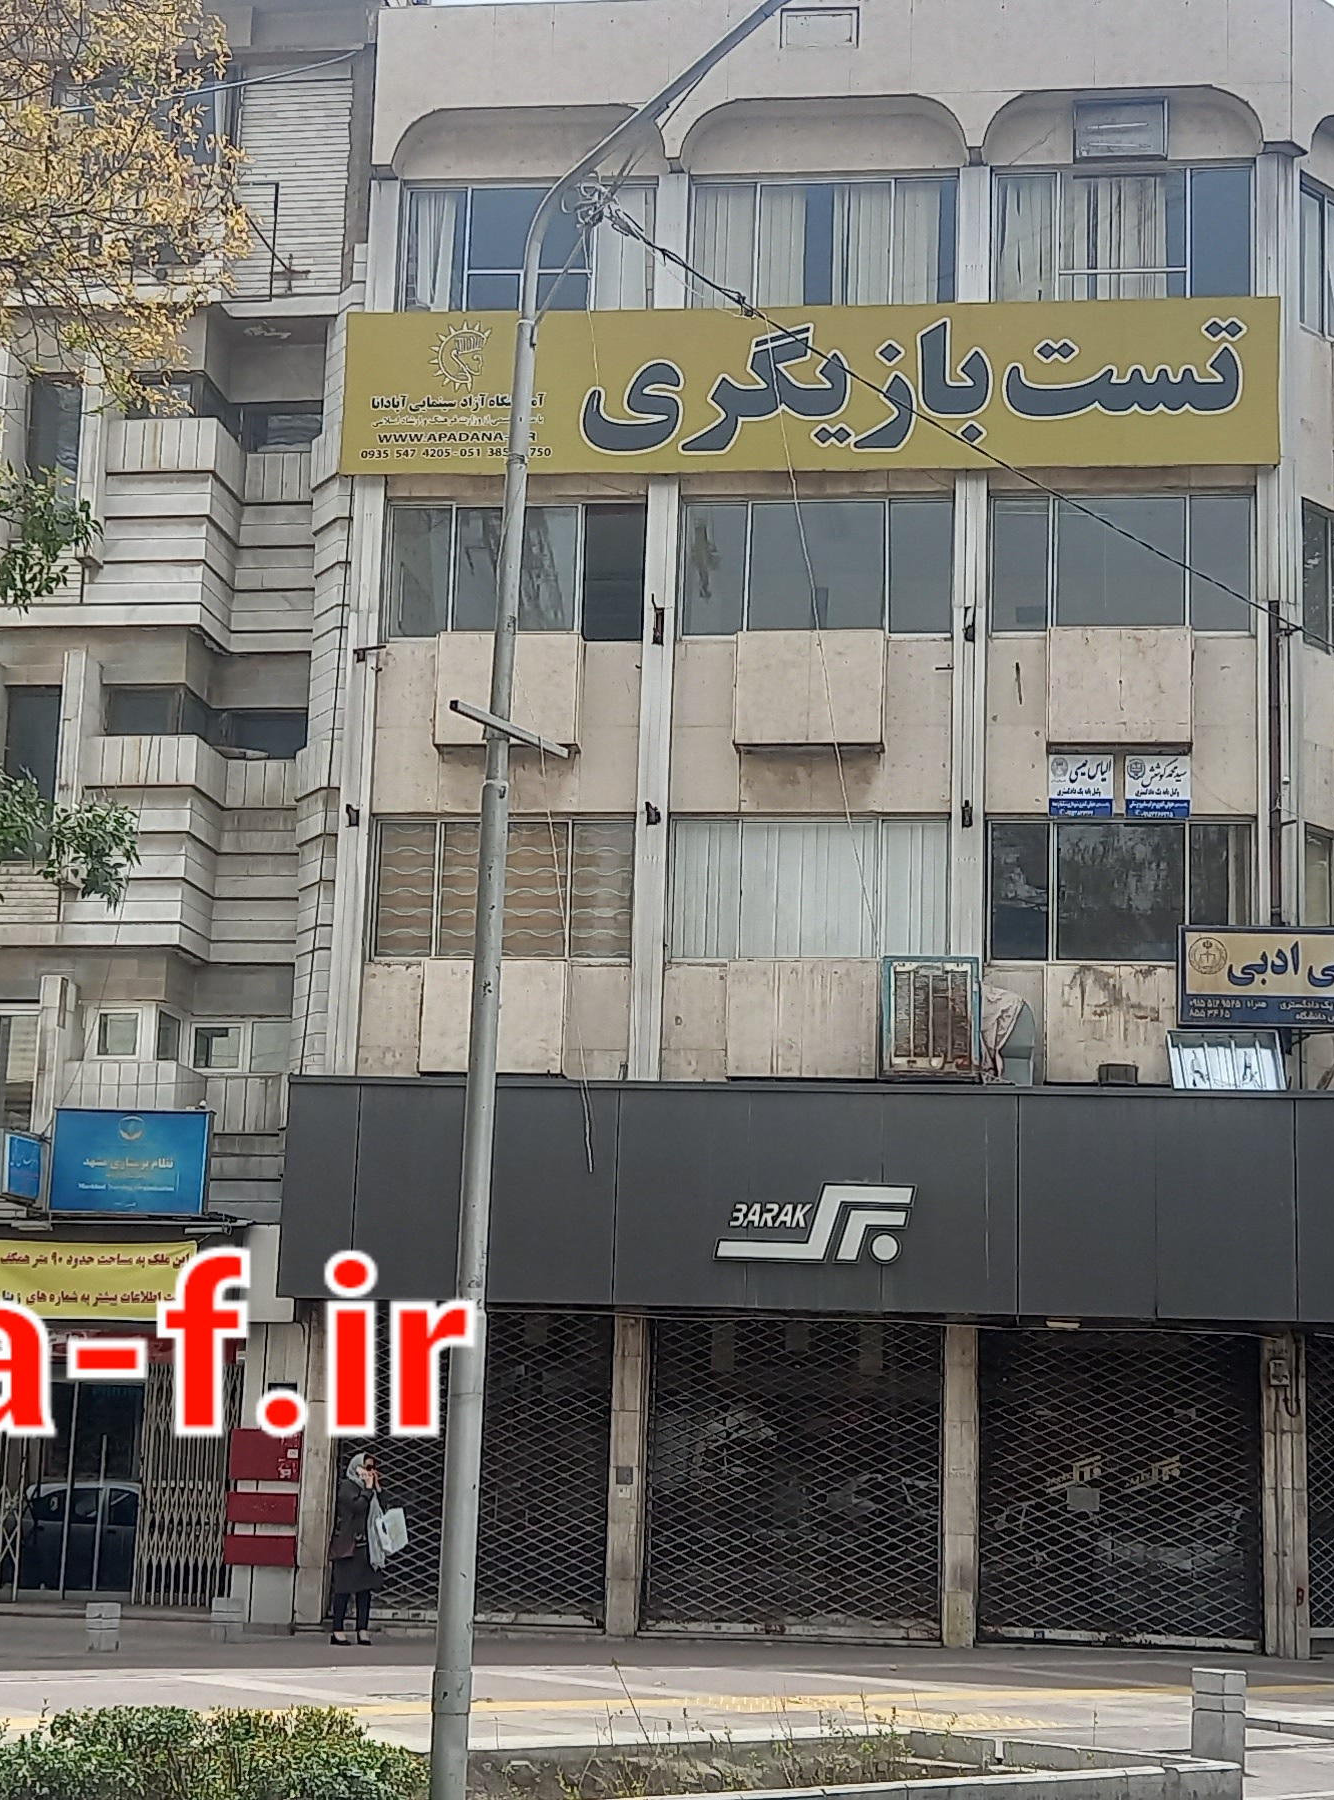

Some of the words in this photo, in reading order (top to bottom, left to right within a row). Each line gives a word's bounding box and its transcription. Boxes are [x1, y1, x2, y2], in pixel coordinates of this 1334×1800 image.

[1004, 317, 1247, 417] تست
[579, 319, 993, 456] بازیگری
[371, 395, 407, 412] آپادانا
[410, 397, 456, 412] سینمایی
[461, 394, 486, 411] آزاد
[361, 449, 389, 459] 0935
[395, 449, 416, 458] 547
[1227, 940, 1300, 986] ادبی
[1247, 1000, 1267, 1010] همراه
[1279, 1000, 1320, 1011] دادگستری
[1320, 1001, 1334, 1010] یک
[1295, 1012, 1327, 1022] دانشگاه
[151, 1157, 174, 1170] نظام
[729, 1203, 813, 1228] BARAK
[0, 1252, 30, 1265] همکف
[31, 1255, 48, 1268] متر
[51, 1252, 63, 1265] ۹۰
[66, 1255, 94, 1269] حدود
[97, 1253, 133, 1265] مساحت
[136, 1255, 146, 1268] به
[148, 1253, 170, 1265] ملک
[173, 1253, 190, 1269] این
[26, 1290, 47, 1306] های
[49, 1290, 78, 1307] شماره
[80, 1293, 90, 1306] به
[120, 1290, 162, 1304] اطلاعات
